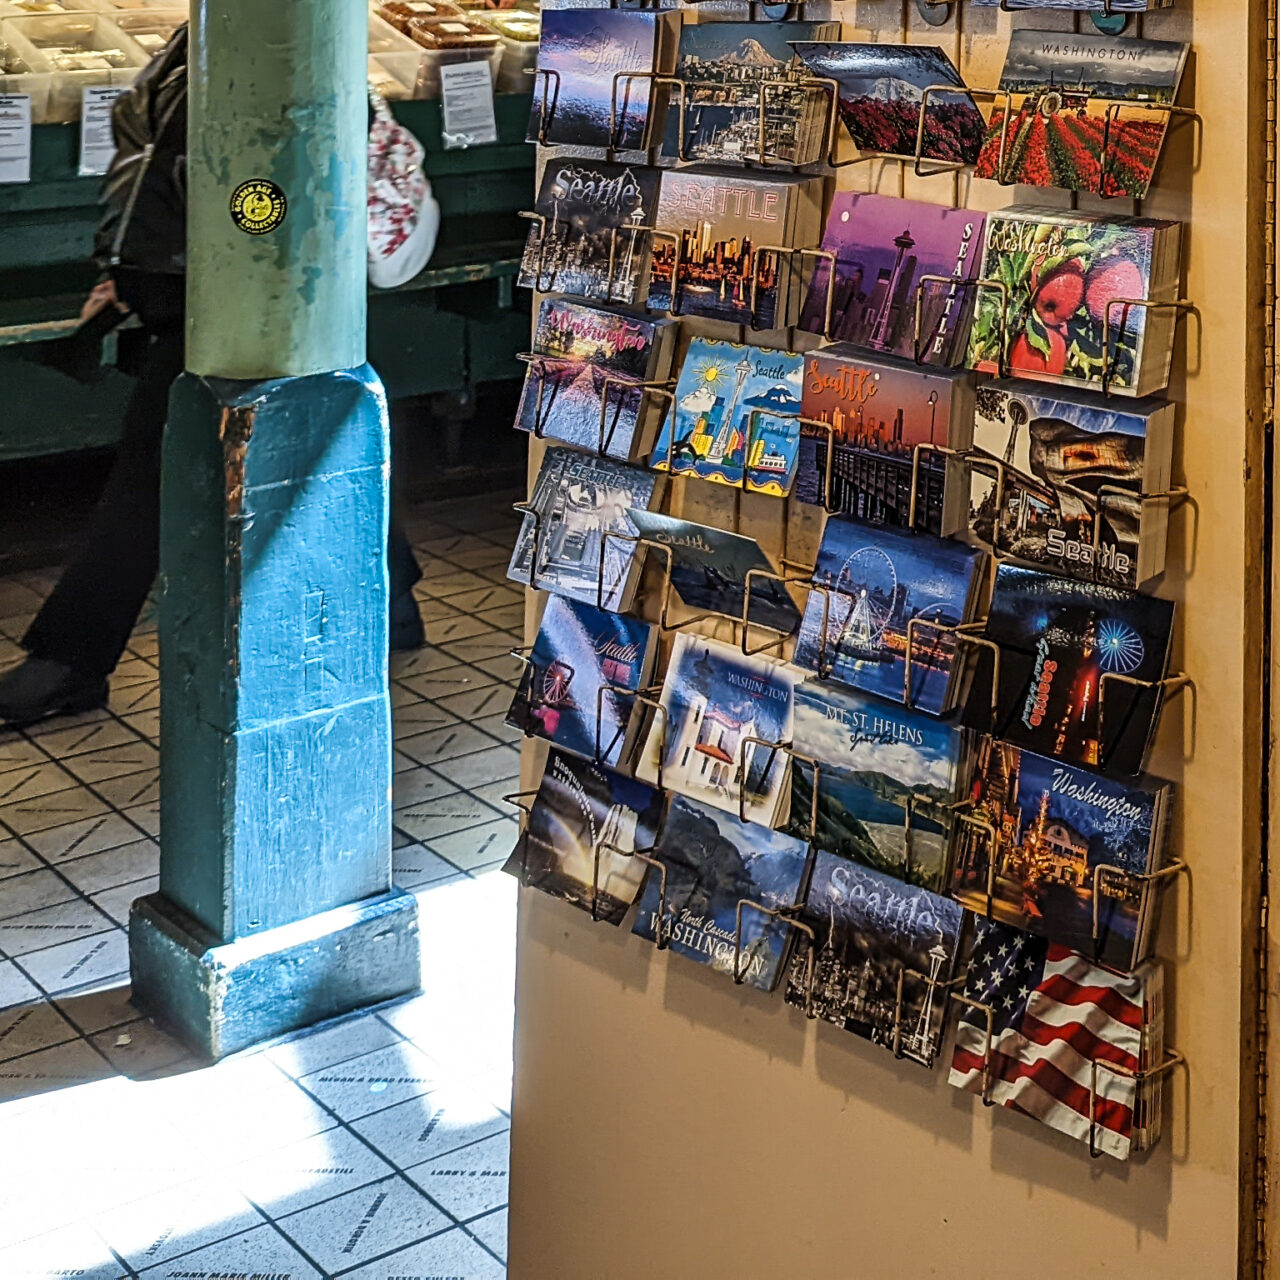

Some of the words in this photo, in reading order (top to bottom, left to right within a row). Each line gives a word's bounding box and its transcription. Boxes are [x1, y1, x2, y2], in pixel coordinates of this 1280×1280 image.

[1041, 43, 1139, 61] WASHINGTON
[554, 168, 636, 207] Seattle
[669, 183, 779, 220] SEATTLE
[986, 221, 1070, 258] Washington
[933, 223, 973, 354] SEATTLE
[550, 308, 645, 351] Washington
[752, 362, 786, 380] Seattle
[806, 359, 880, 403] Seattle
[570, 463, 626, 488] SEATTLE
[656, 531, 715, 554] Seattle
[1046, 528, 1131, 574] Seattle
[594, 630, 641, 663] Seattle
[728, 671, 789, 703] WASHINGTON
[852, 712, 870, 731] ST.
[873, 717, 924, 746] HELENS
[1051, 767, 1142, 820] Washington
[831, 865, 933, 923] Seattle
[680, 907, 703, 929] North
[649, 911, 765, 976] WASHINGTON
[167, 1271, 206, 1279] JOANN
[208, 1272, 248, 1280] MARIE
